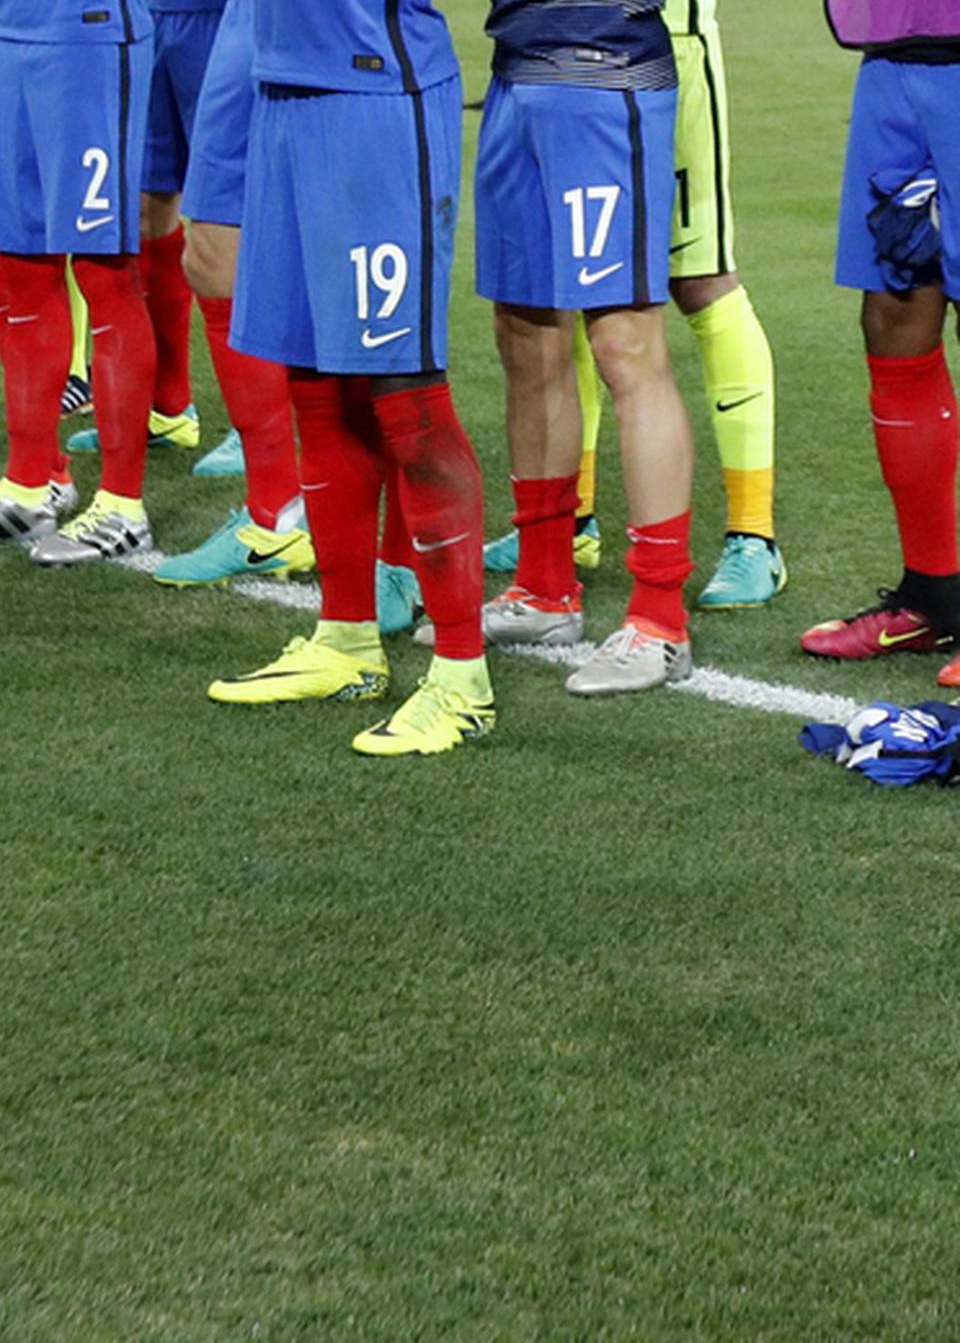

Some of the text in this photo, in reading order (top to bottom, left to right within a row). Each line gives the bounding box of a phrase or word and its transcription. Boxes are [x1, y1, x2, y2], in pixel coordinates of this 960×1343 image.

[82, 148, 110, 209] 2
[563, 185, 620, 258] 17
[350, 242, 408, 319] 19
